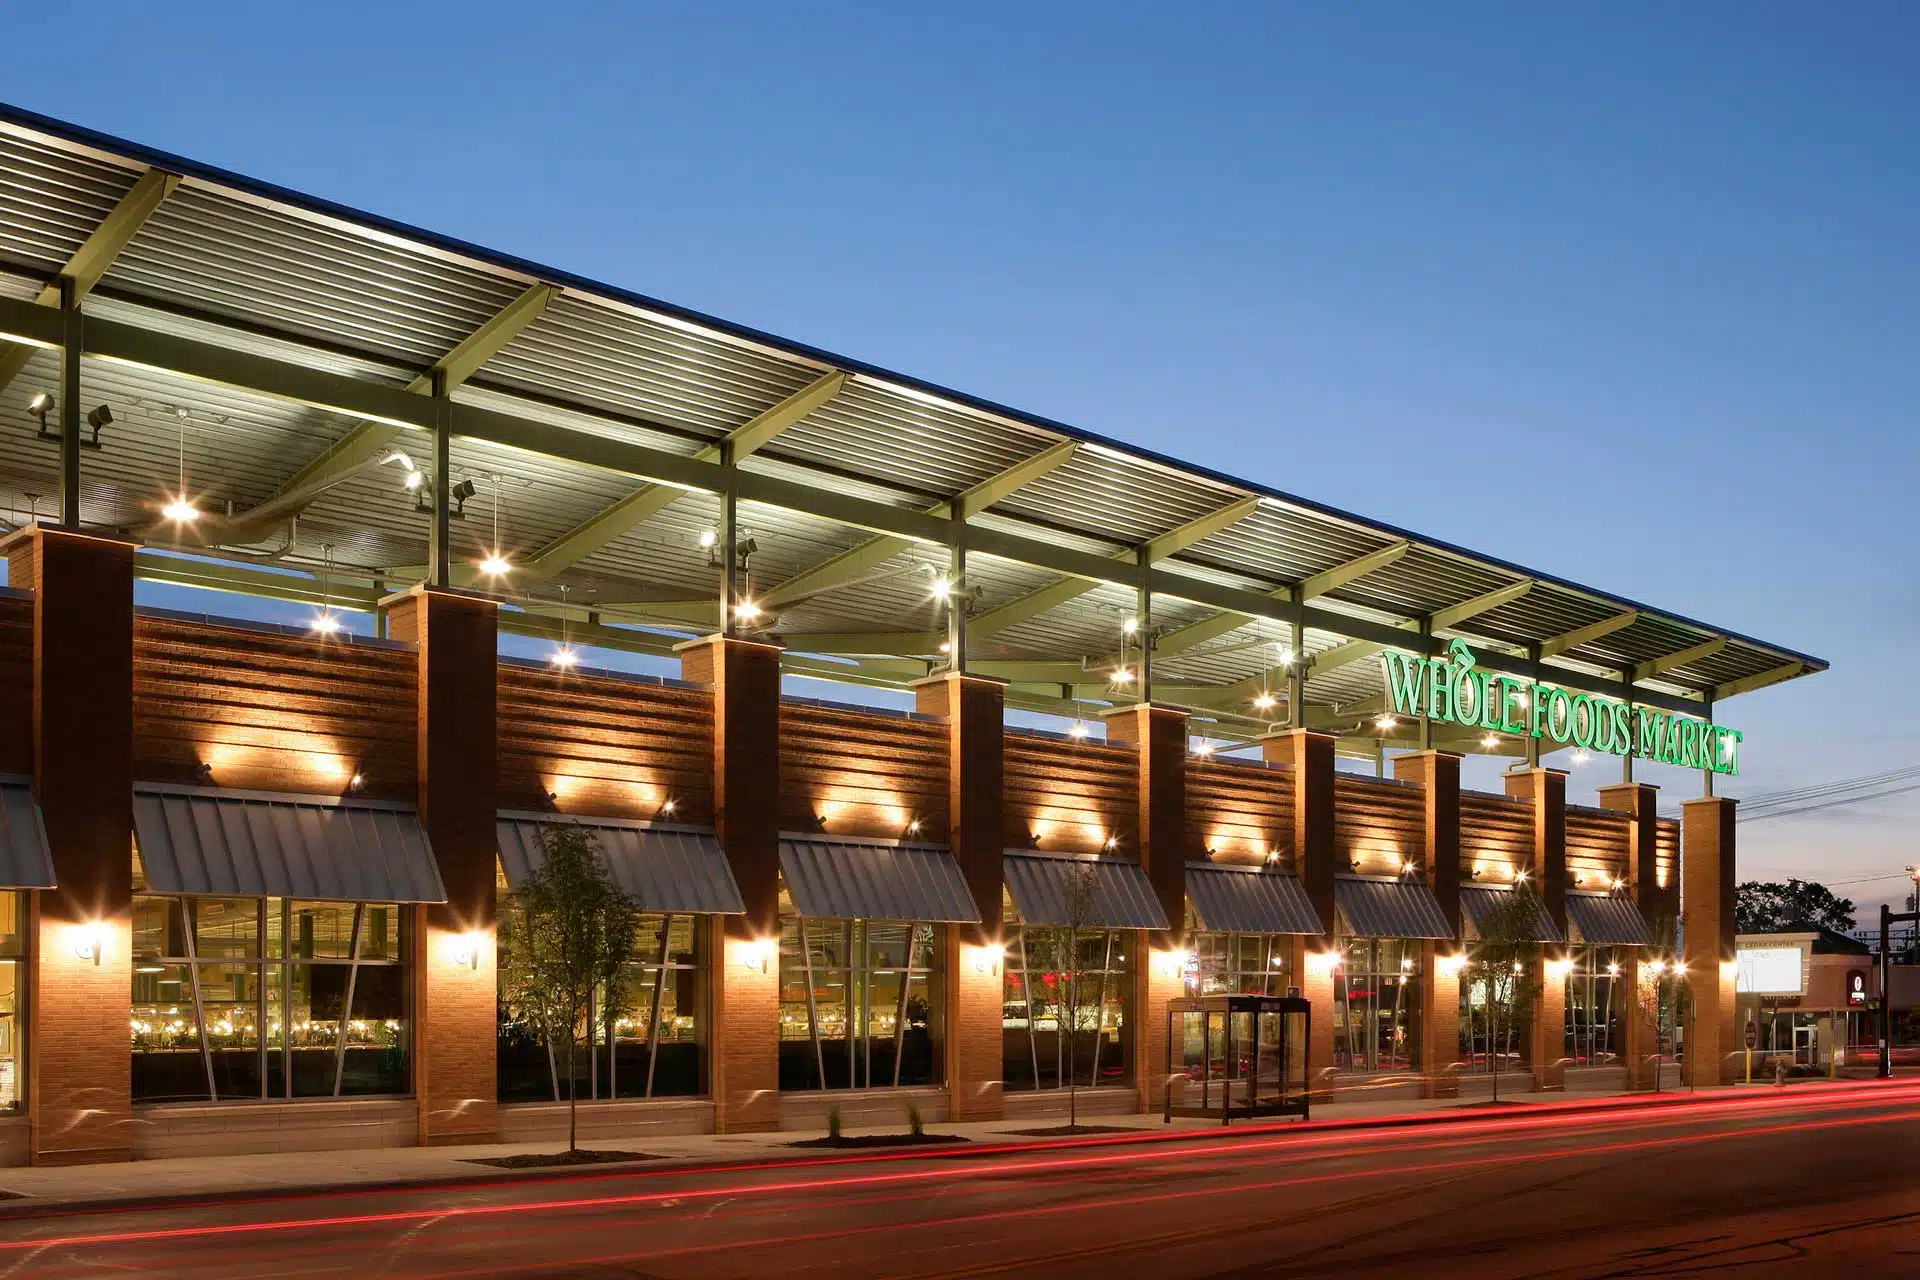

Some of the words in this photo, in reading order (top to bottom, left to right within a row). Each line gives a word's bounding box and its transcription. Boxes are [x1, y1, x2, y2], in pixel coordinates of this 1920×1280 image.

[1382, 637, 1522, 734] WHOLE
[1530, 684, 1631, 756] FOODS
[1638, 709, 1743, 776] MARKET
